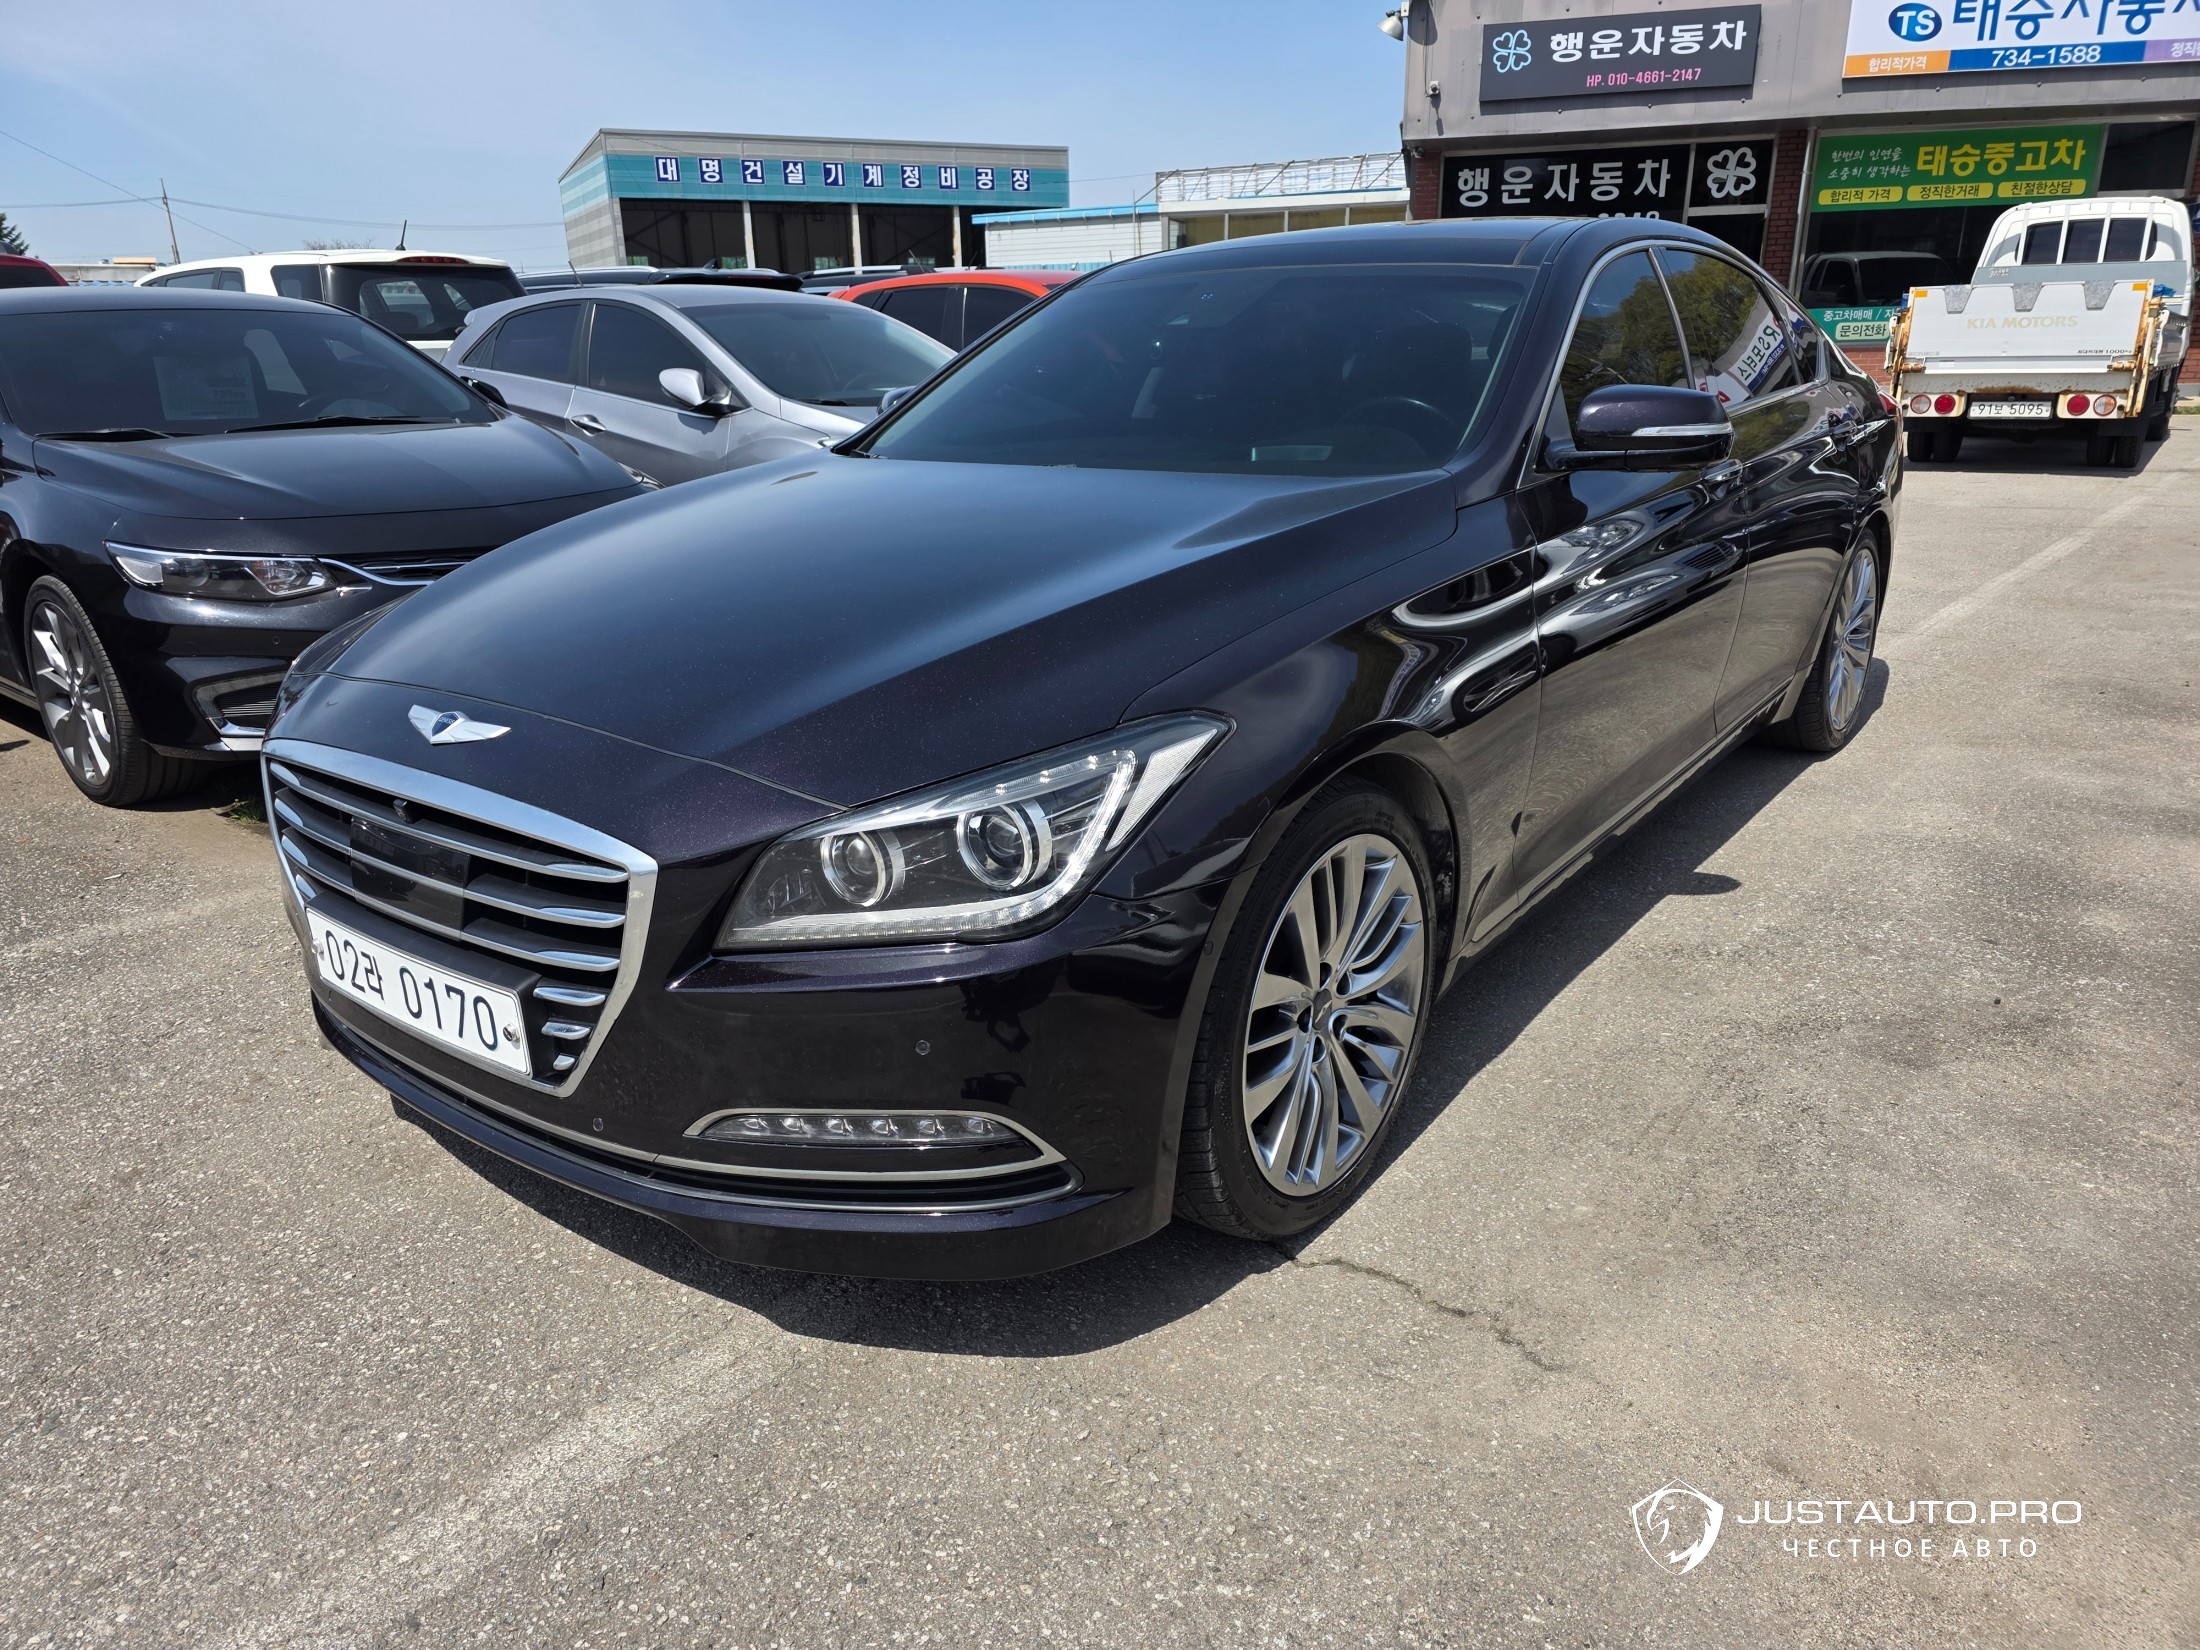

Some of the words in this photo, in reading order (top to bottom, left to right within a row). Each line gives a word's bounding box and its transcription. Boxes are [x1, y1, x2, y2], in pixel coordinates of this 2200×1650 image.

[1897, 10, 1935, 36] TS
[1952, 0, 2200, 42] 태승자동
[1550, 20, 1747, 63] 행운자동차
[1868, 56, 1927, 72] 합리적가격
[1991, 45, 2101, 67] 734-1588
[1586, 75, 1605, 87] HP.
[1608, 68, 1702, 86] 010-4661-2147
[1831, 149, 1865, 163] 한번의
[1869, 147, 1902, 162] 인연을
[1916, 138, 2086, 177] 태승중고차
[657, 157, 1031, 192] 대명건설기계정비공장
[1827, 166, 1863, 181] 소중히
[1866, 165, 1911, 179] 생각하는
[1457, 158, 1672, 208] 행운자동차
[1919, 183, 1980, 199] 정직한거래
[2011, 181, 2073, 196] 친절한상담
[1830, 189, 1864, 203] 합리적
[1867, 187, 1891, 201] 가격
[1823, 309, 1873, 322] 중고차매매
[1966, 317, 1997, 330] KIA
[2001, 314, 2079, 329] MOTORS
[1839, 323, 1887, 338] 문의전화
[1978, 403, 2004, 415] 91보
[2009, 403, 2043, 415] 5095
[325, 929, 385, 1001] 02라
[399, 965, 498, 1051] 0170
